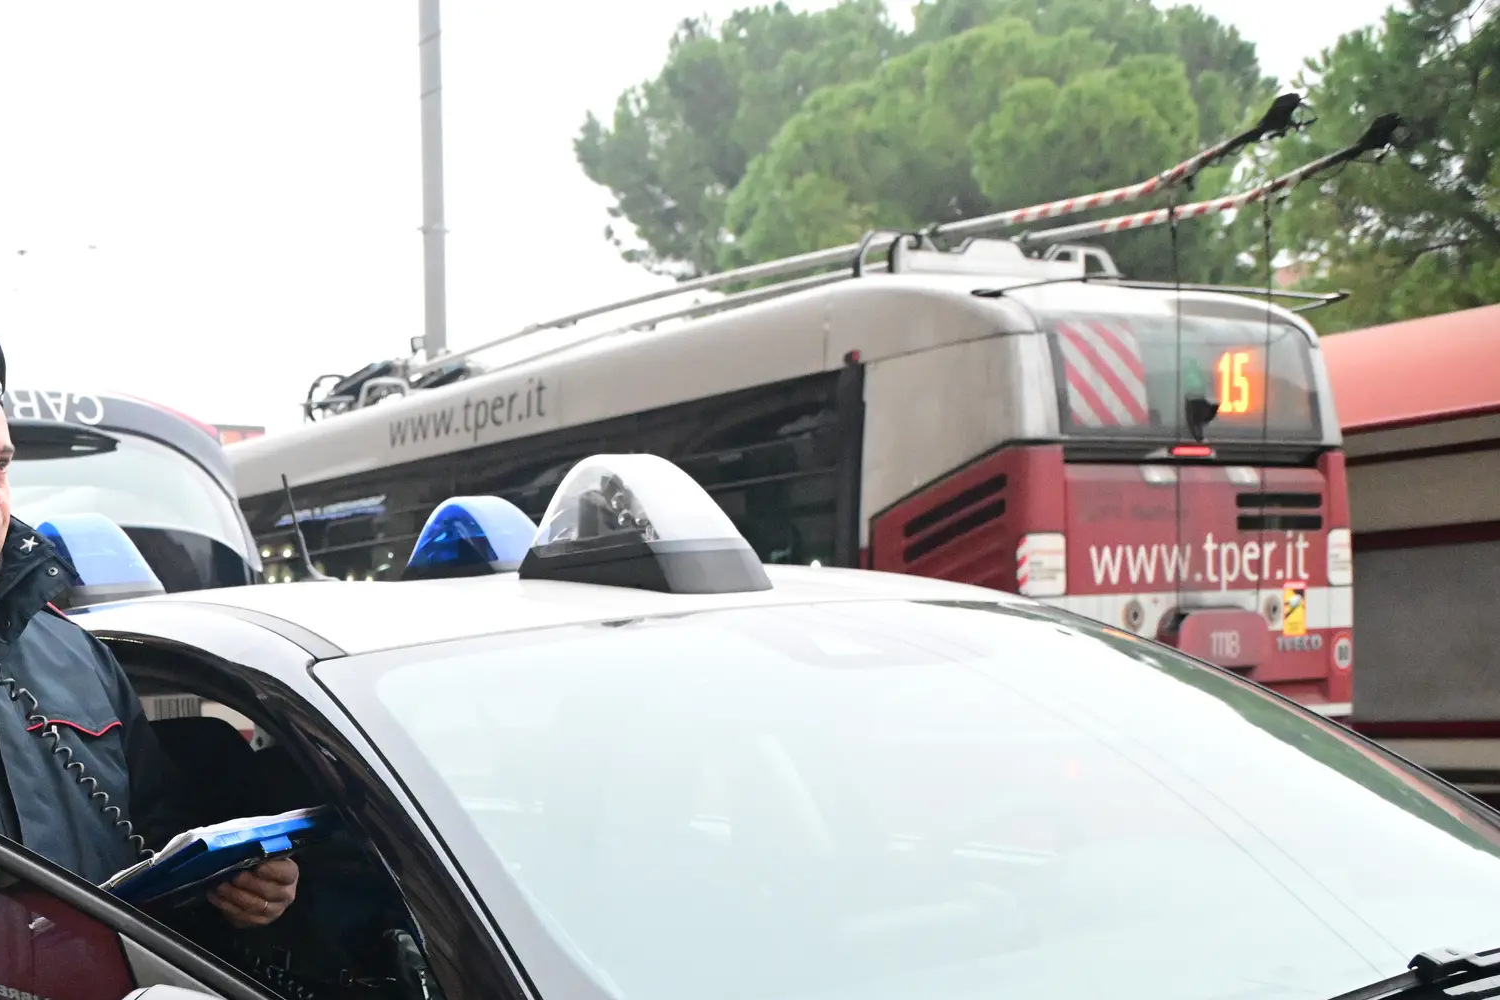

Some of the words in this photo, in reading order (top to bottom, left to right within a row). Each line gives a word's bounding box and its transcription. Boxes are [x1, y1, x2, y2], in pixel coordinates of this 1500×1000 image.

[389, 376, 546, 448] www.tper.it
[1218, 351, 1249, 413] 15
[1089, 531, 1310, 591] www.tper.it
[1209, 631, 1241, 658] 1118
